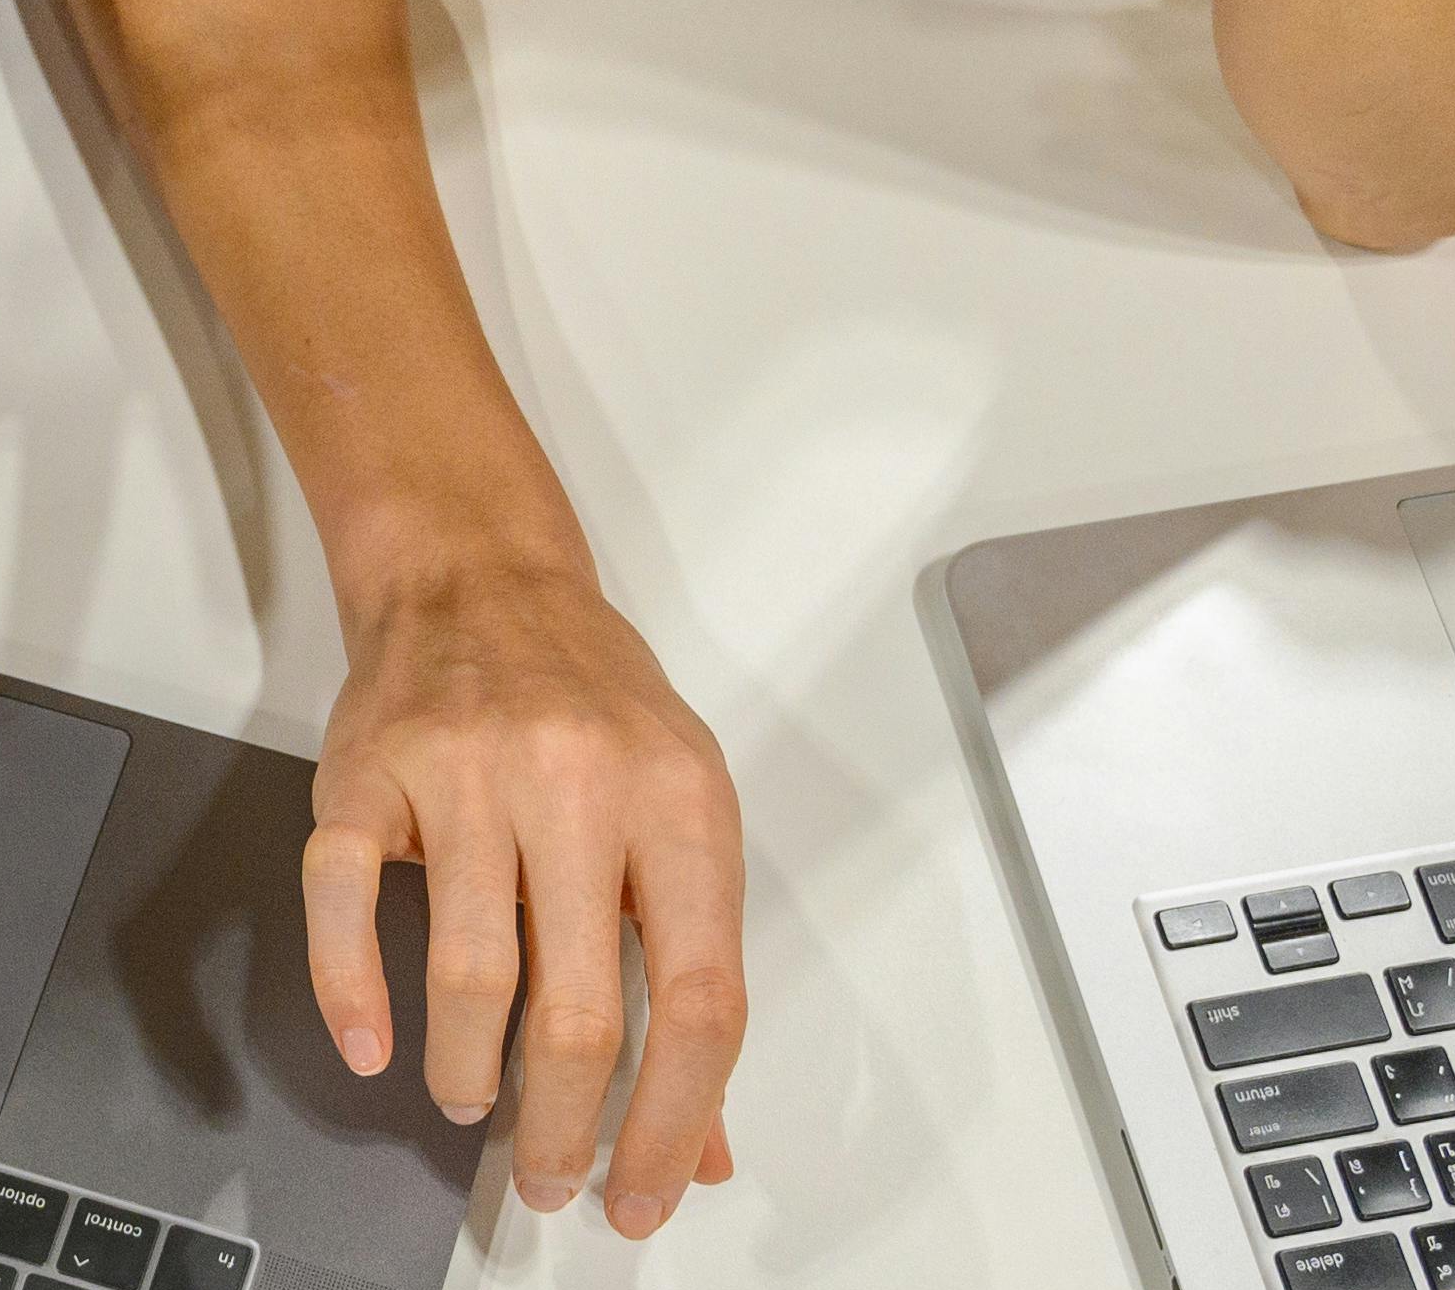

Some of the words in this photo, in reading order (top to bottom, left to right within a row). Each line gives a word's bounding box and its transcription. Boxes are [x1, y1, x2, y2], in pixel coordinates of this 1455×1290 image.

[1205, 1004, 1240, 1024] shift
[1233, 1084, 1281, 1103] return
[1248, 1121, 1281, 1136] enter
[83, 1211, 143, 1237] control
[217, 1251, 235, 1269] fn
[1294, 1251, 1344, 1272] delete
